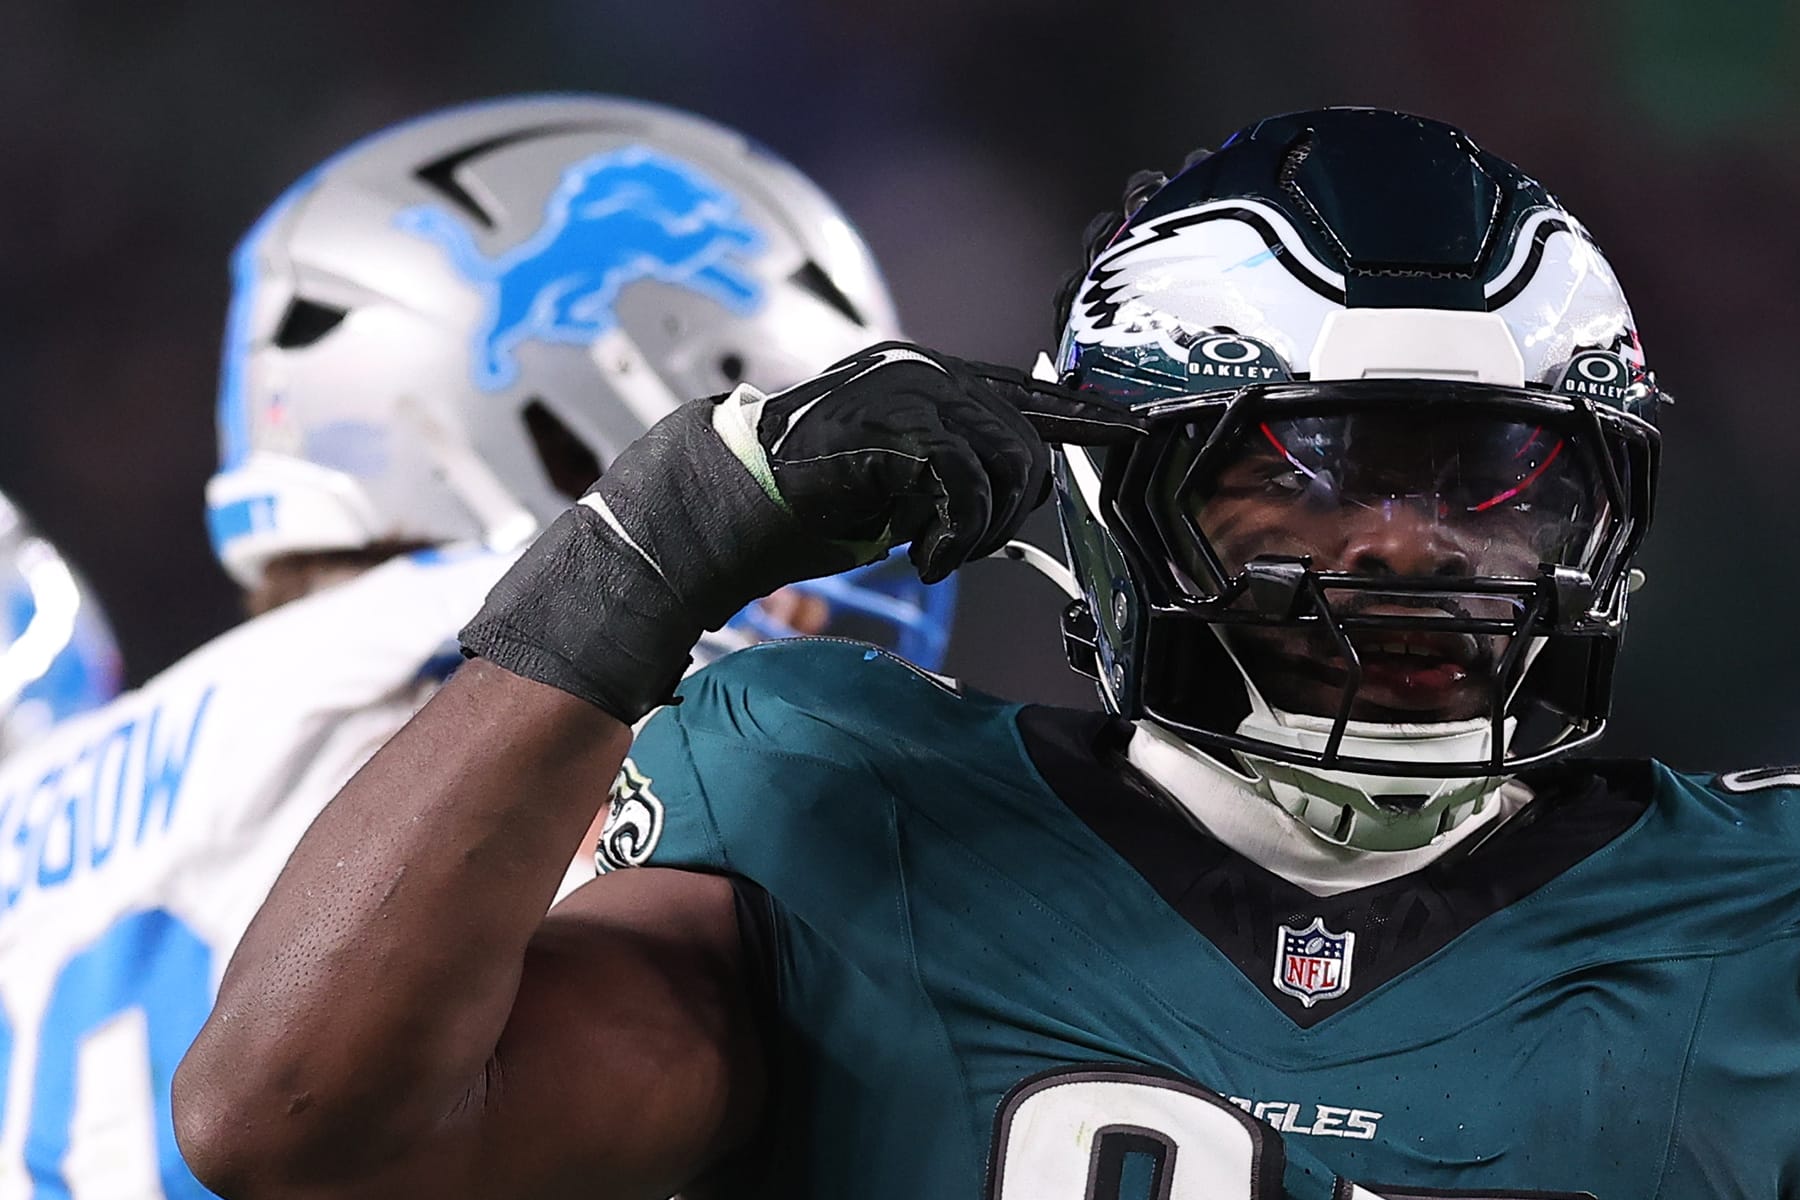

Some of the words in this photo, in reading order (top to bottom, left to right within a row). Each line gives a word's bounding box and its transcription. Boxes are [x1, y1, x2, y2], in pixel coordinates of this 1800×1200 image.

[1188, 362, 1273, 379] OAKLEY
[1565, 379, 1624, 399] OAKLEY
[0, 682, 217, 918] SGOW
[1287, 956, 1336, 990] NFL
[1219, 1093, 1383, 1140] GLES
